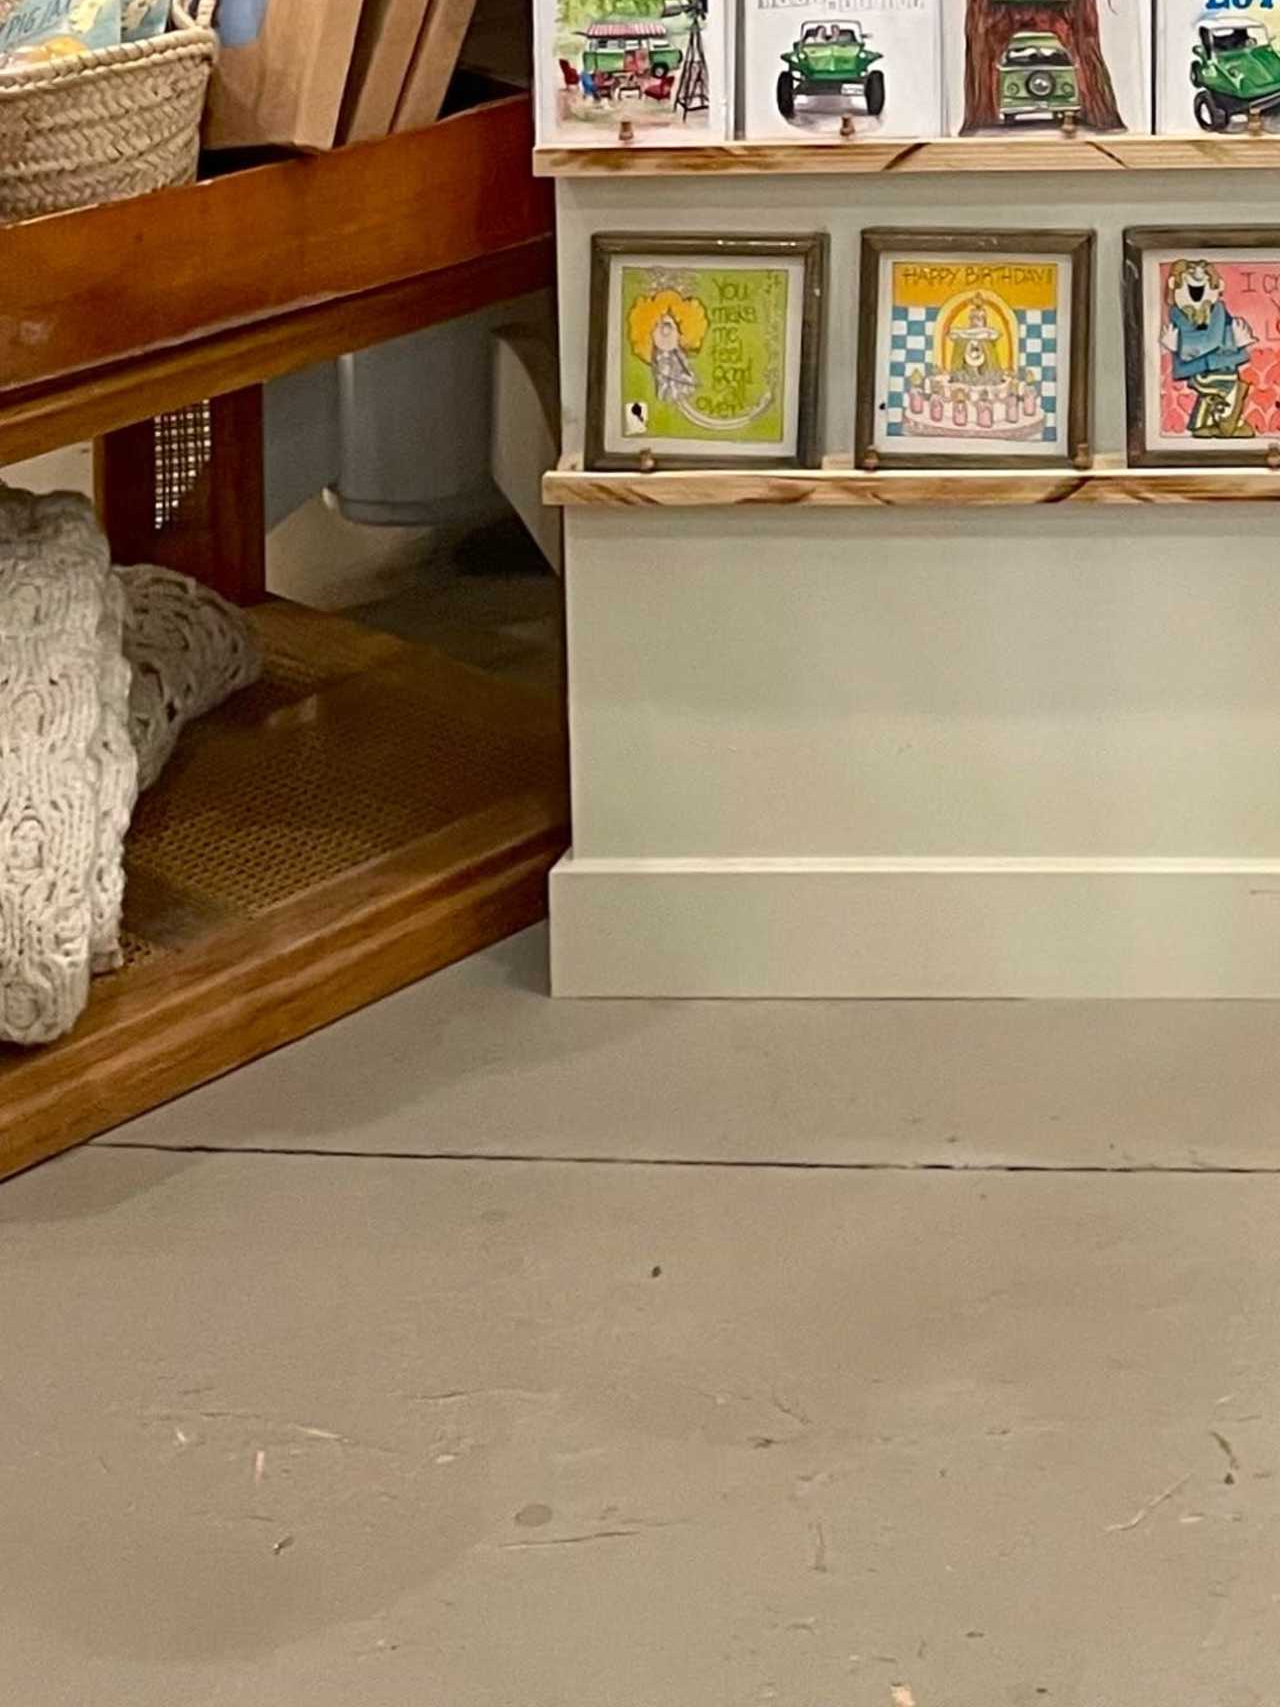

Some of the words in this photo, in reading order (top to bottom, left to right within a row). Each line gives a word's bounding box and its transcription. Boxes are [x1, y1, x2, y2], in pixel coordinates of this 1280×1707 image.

[902, 267, 958, 287] HAPPY
[1240, 270, 1257, 294] I
[712, 277, 749, 302] You
[711, 305, 757, 324] make
[711, 326, 738, 343] me
[711, 339, 743, 363] feel
